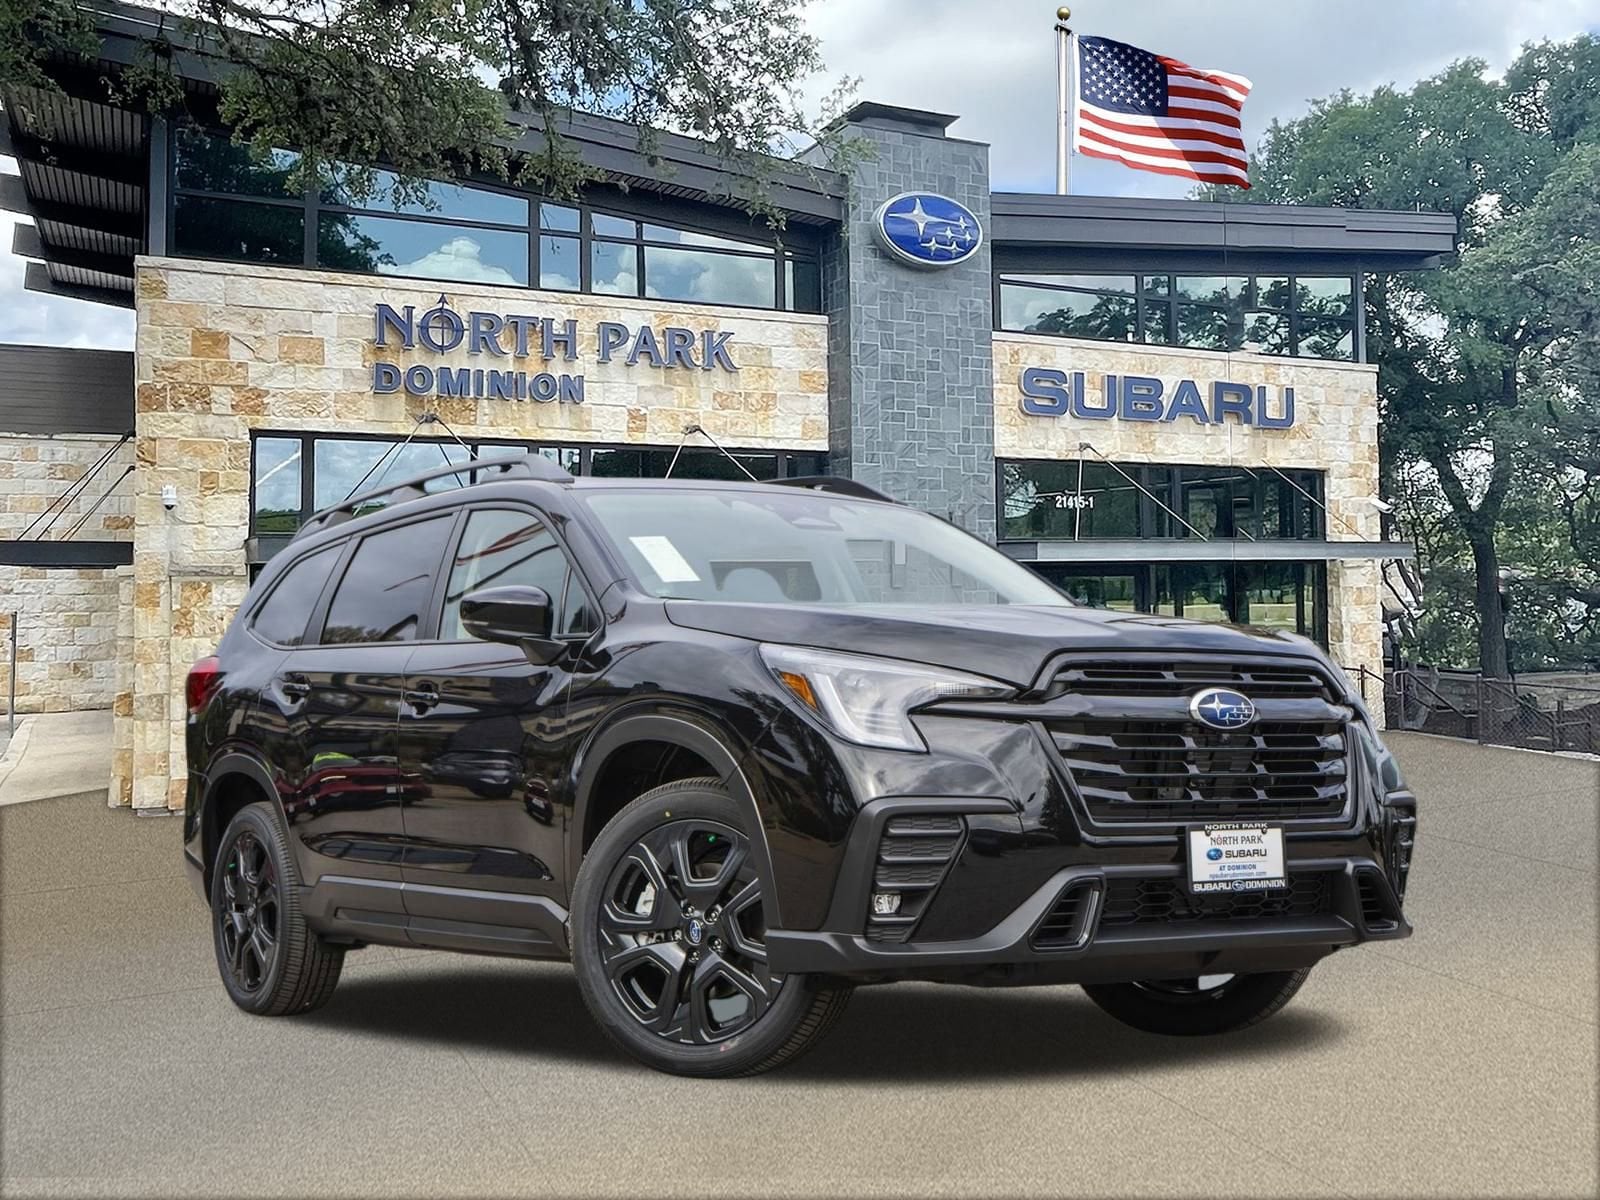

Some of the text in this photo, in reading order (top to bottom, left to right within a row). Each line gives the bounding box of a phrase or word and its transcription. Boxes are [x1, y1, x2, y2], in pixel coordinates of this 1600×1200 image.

[374, 299, 740, 373] NORTH PARK
[372, 361, 586, 405] DOMINION
[1019, 367, 1295, 430] SUBARU
[1204, 823, 1239, 831] NORTH
[1210, 834, 1264, 846] NORTH PARK
[1225, 848, 1267, 858] SUBARU
[1193, 879, 1286, 891] SUBARU DOMINION
